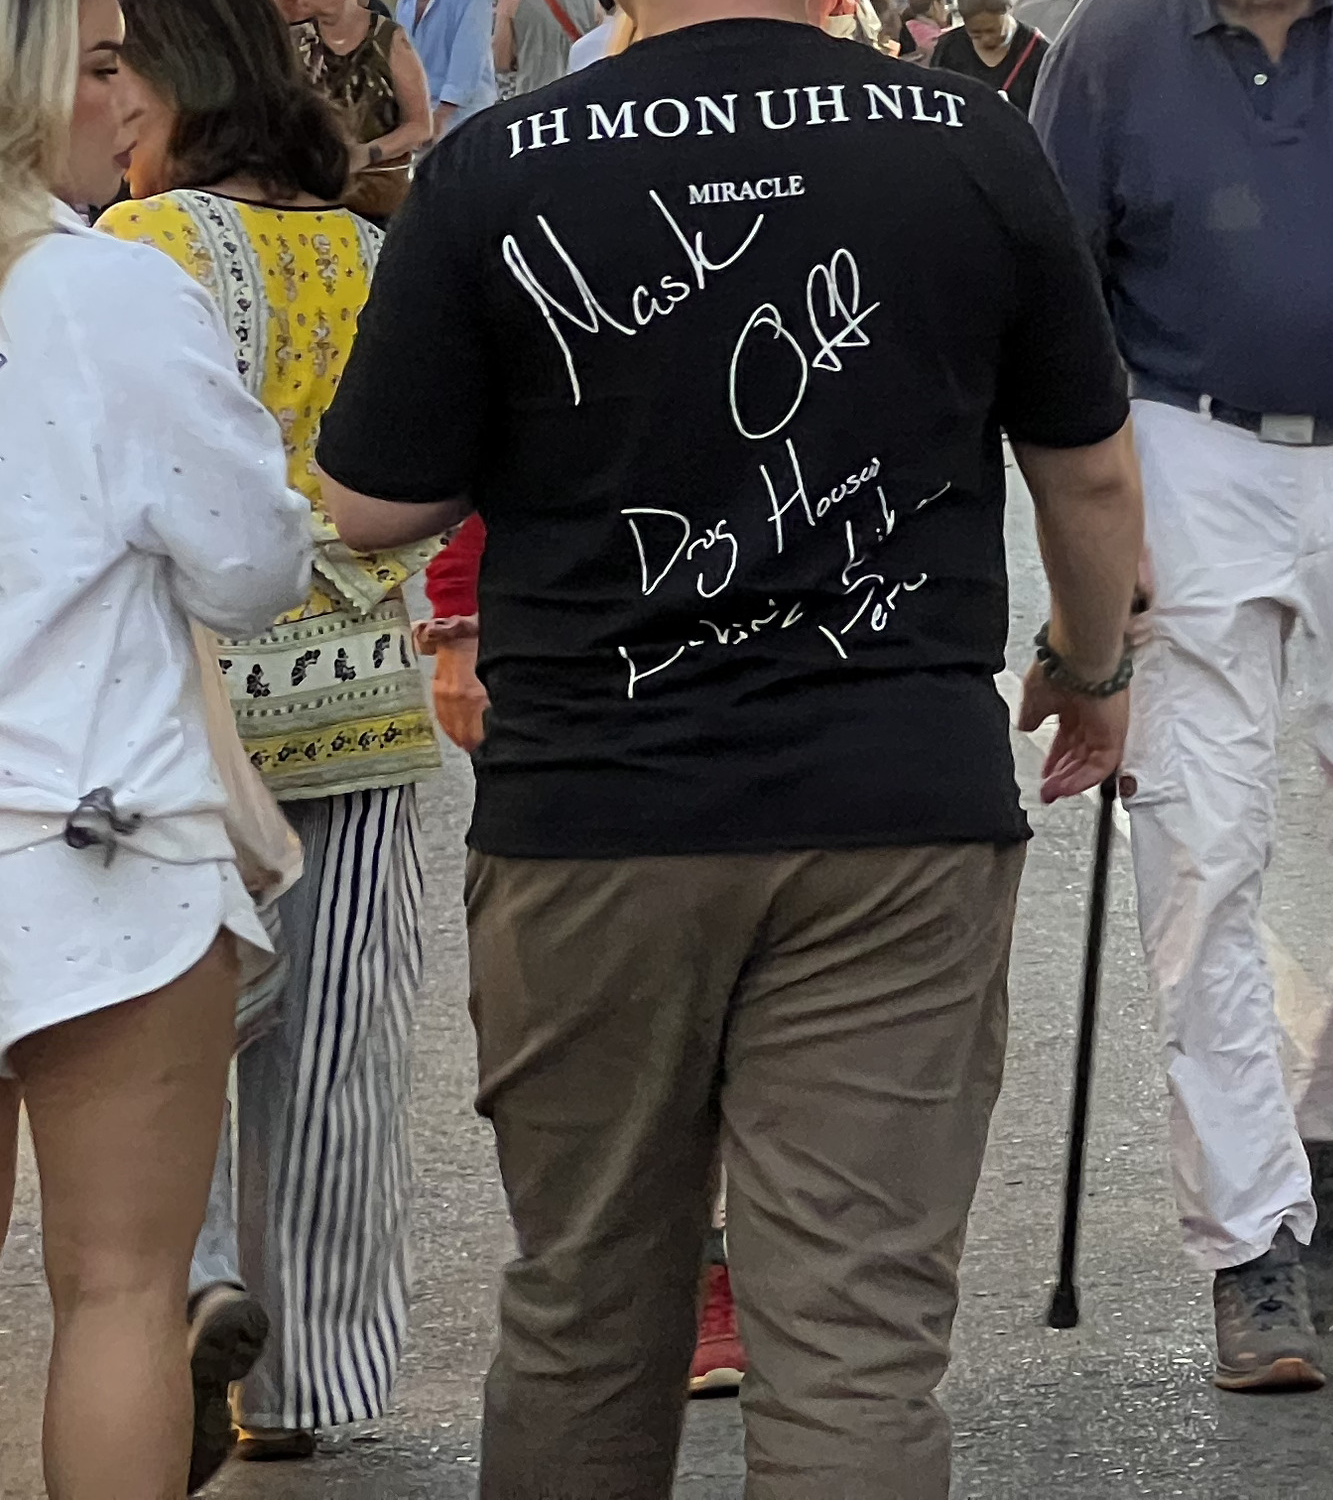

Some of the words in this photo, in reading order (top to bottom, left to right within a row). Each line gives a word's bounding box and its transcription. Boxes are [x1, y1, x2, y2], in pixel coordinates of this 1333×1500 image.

[506, 108, 570, 158] IH
[586, 93, 738, 140] MON
[755, 85, 851, 130] UH
[862, 83, 966, 127] NLT
[688, 175, 806, 205] MIRACLE
[502, 190, 765, 406] Mask
[730, 248, 880, 439] Off
